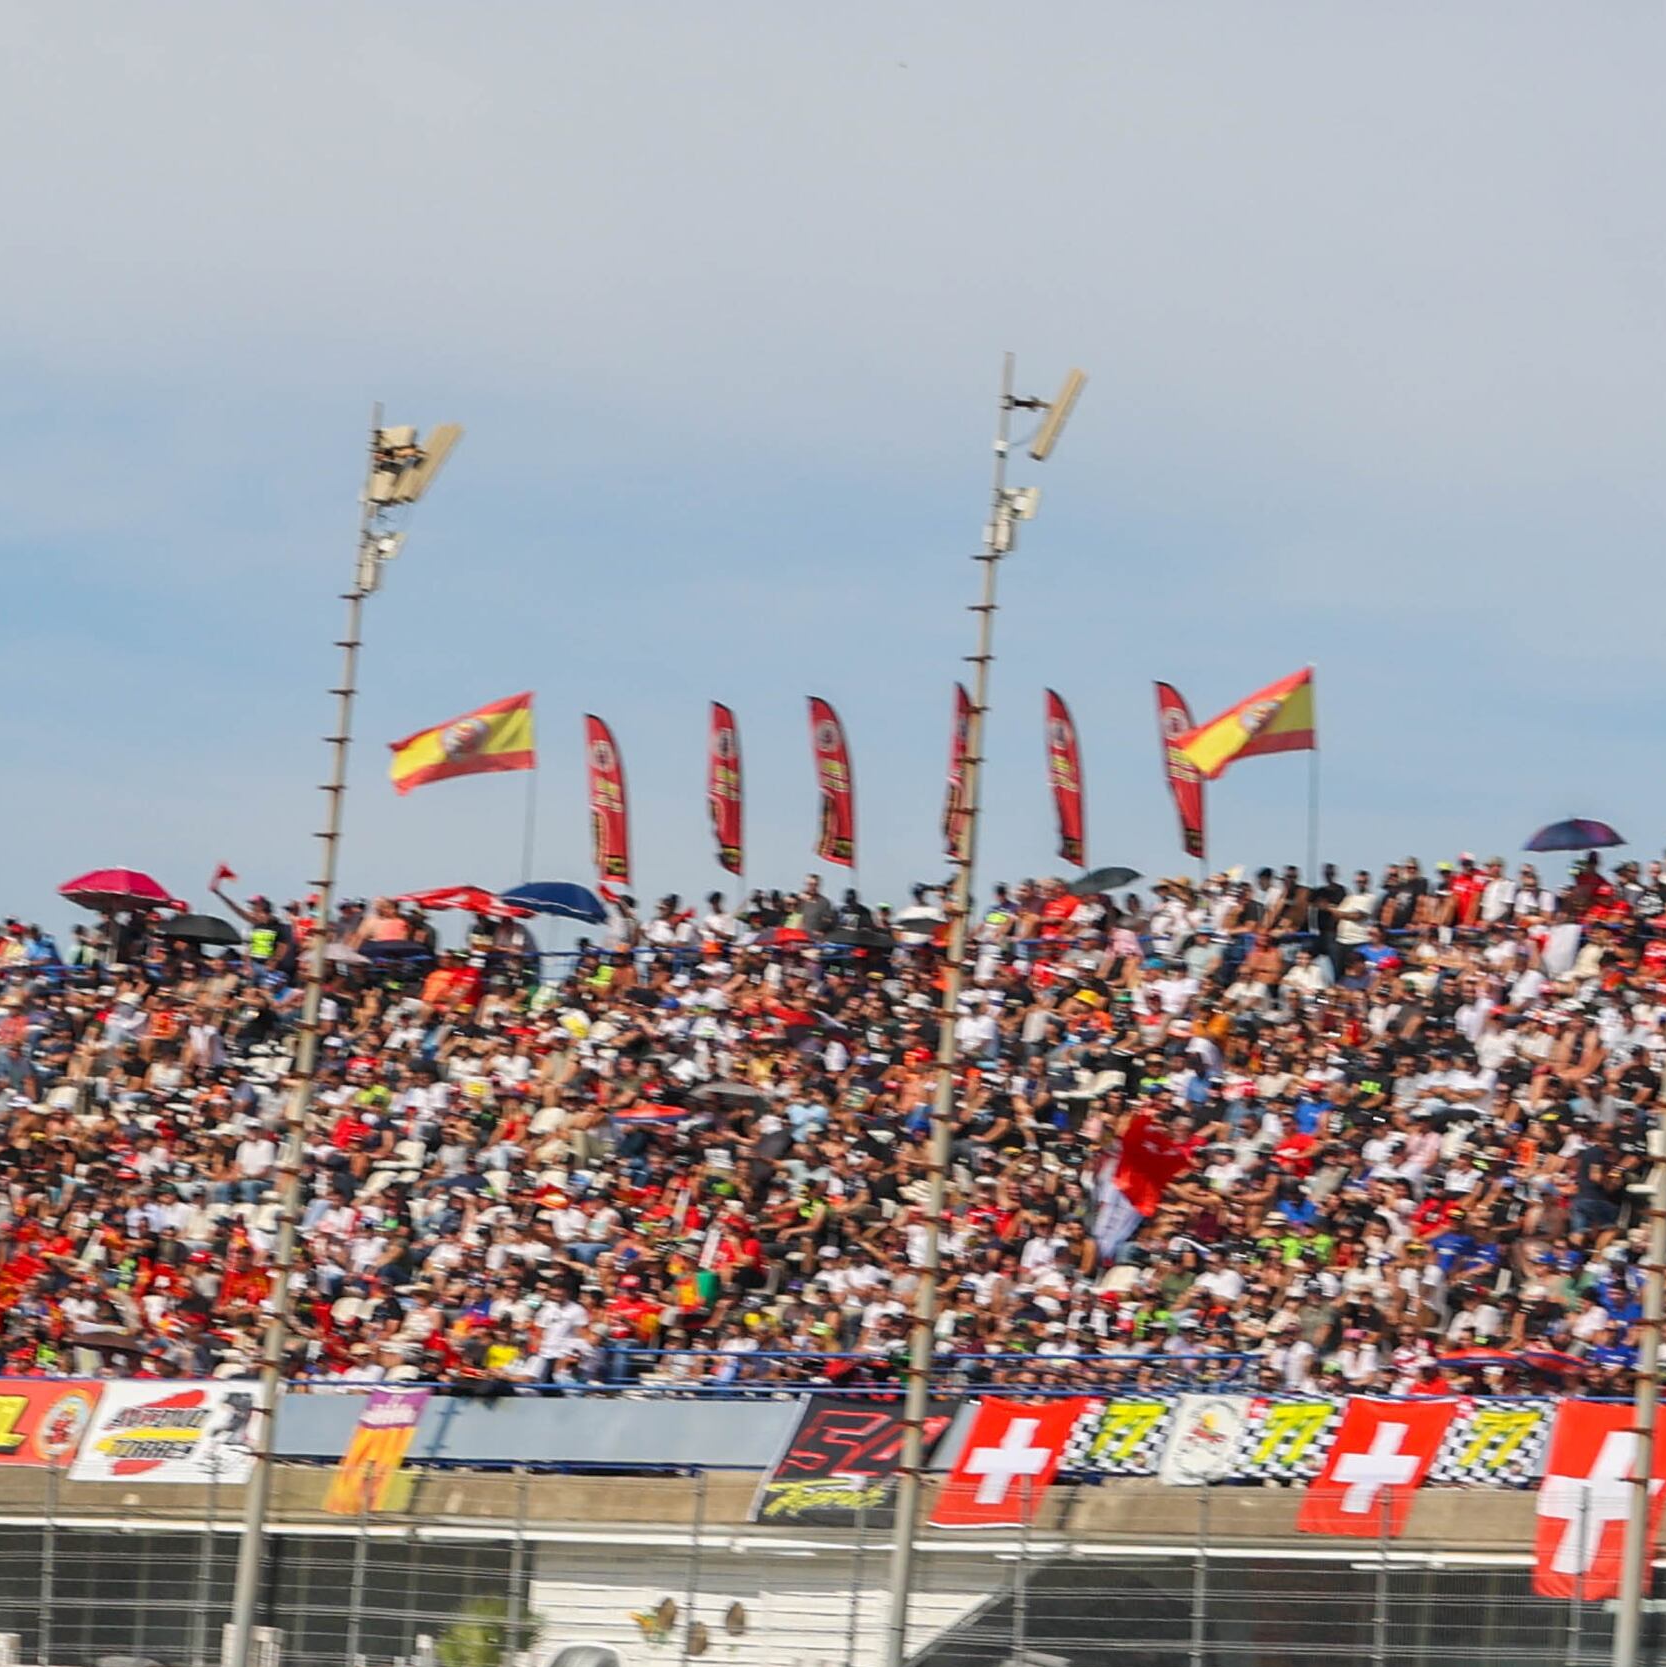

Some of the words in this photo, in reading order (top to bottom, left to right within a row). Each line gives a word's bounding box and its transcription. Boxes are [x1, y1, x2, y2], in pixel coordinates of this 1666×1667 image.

[1089, 1401, 1167, 1460] 77
[1252, 1401, 1334, 1464] 77
[1459, 1411, 1541, 1469] 77
